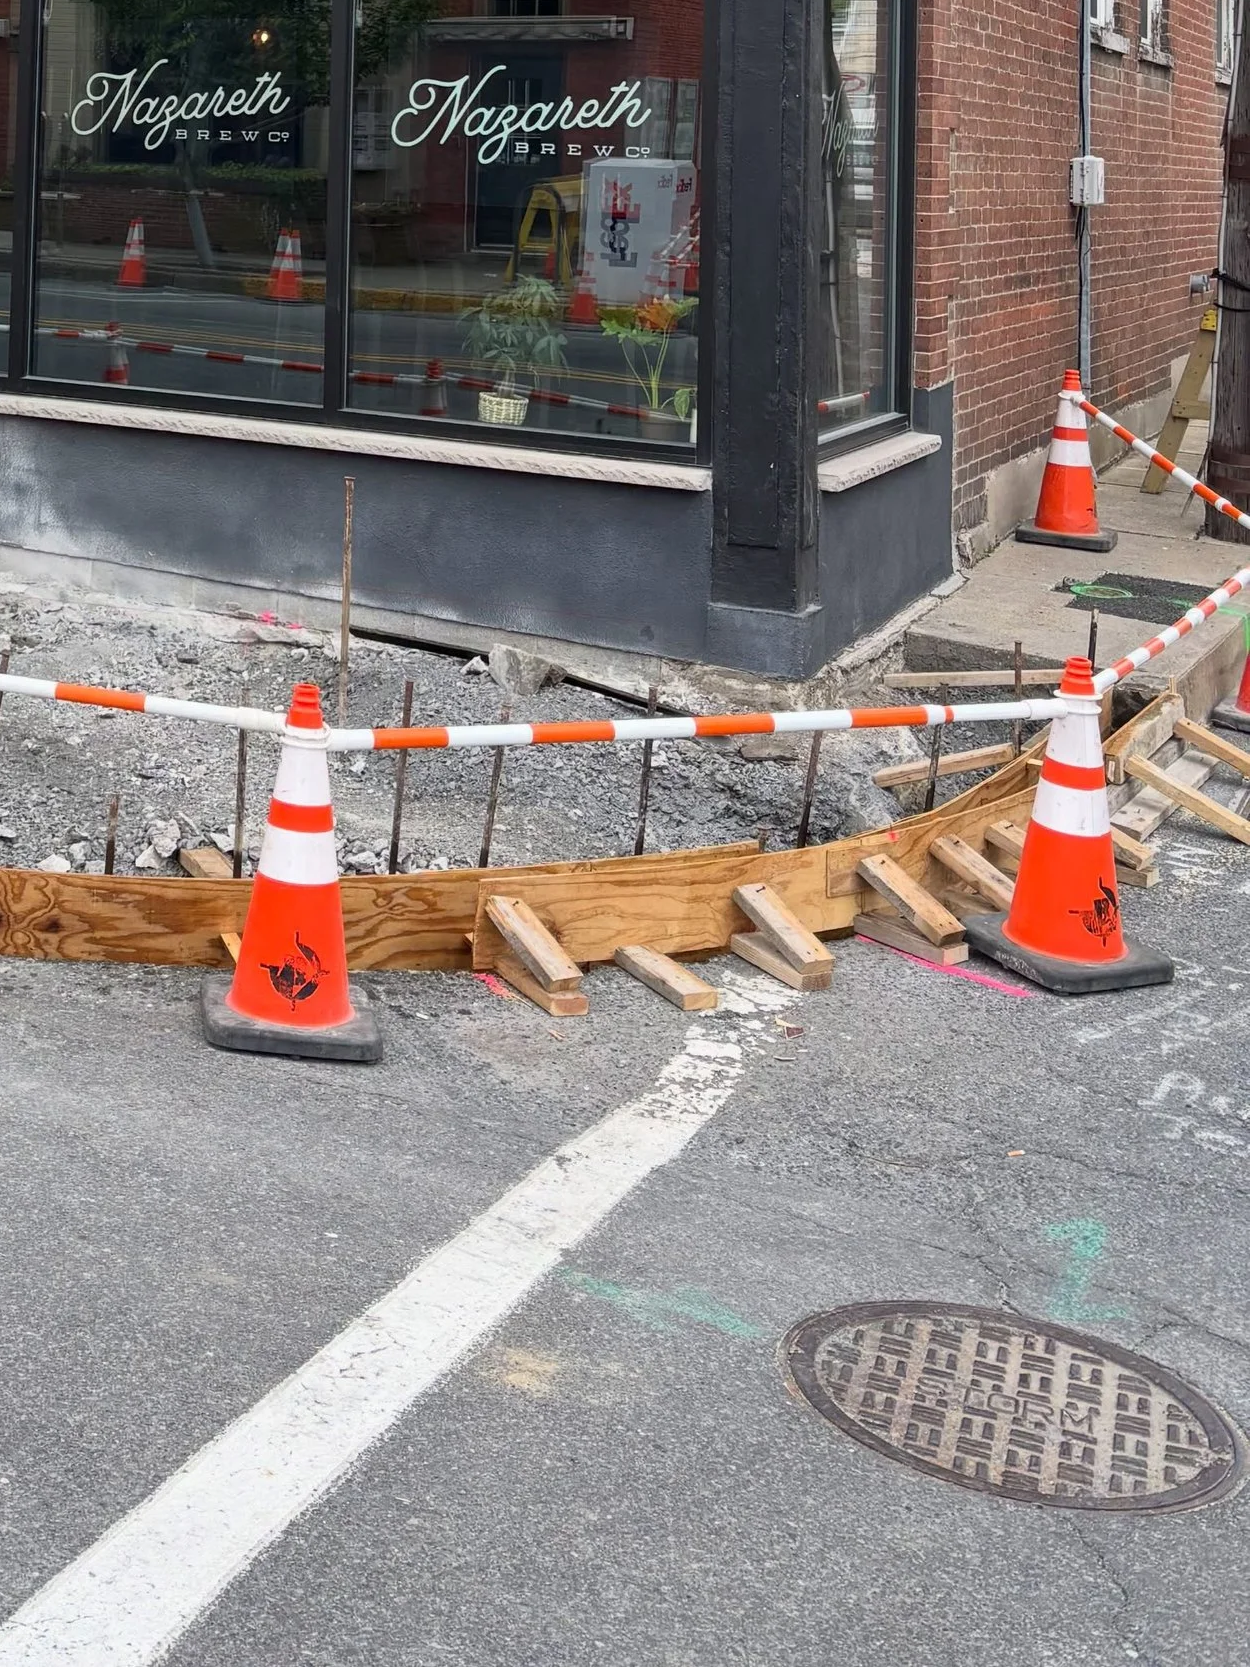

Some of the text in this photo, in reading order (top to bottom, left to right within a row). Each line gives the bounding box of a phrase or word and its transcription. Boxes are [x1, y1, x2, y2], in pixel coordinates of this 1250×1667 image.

[70, 58, 291, 151] Nazareth
[390, 64, 653, 165] Nazareth
[175, 128, 260, 143] BREW
[514, 141, 616, 157] BREW
